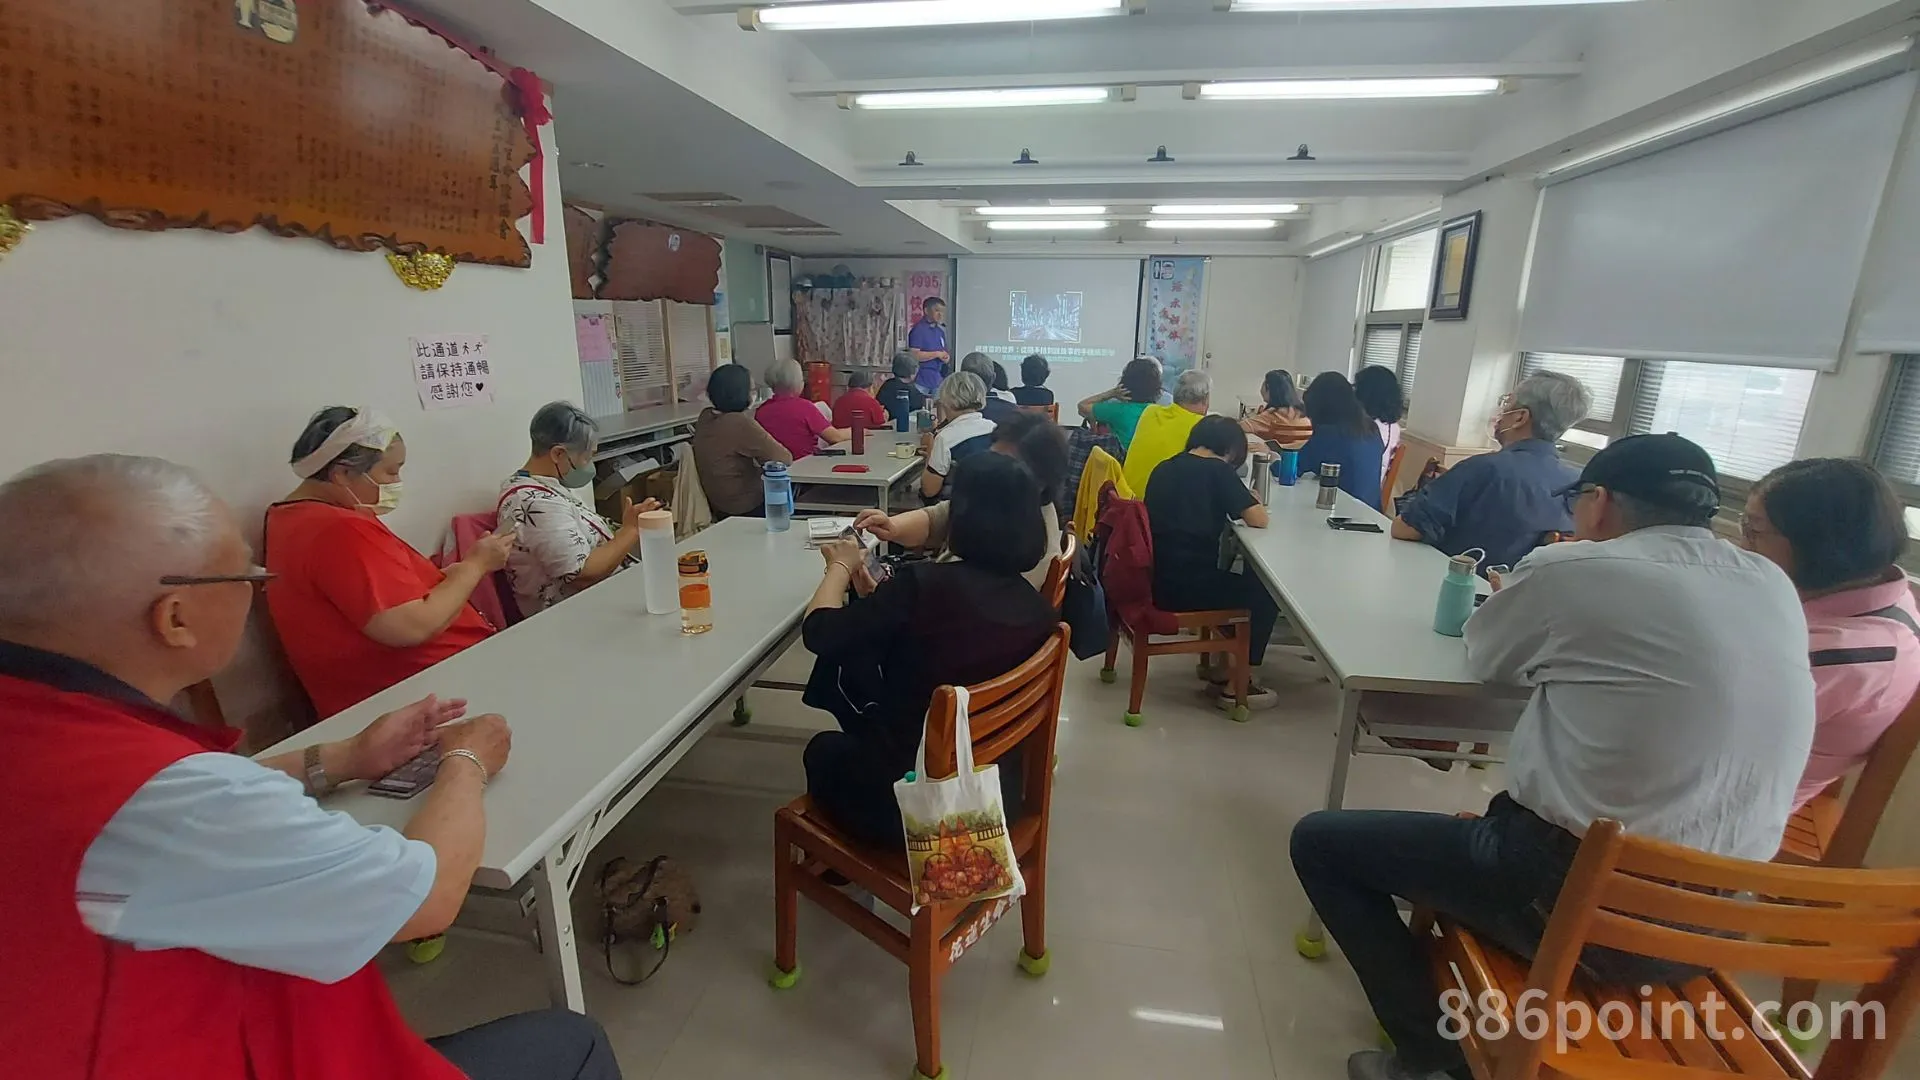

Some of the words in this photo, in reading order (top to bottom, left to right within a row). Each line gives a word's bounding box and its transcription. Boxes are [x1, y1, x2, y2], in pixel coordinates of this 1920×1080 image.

[911, 275, 939, 289] 1995
[416, 341, 459, 358] 此通道
[420, 360, 489, 380] 請保持通暢
[431, 381, 473, 400] 感謝您
